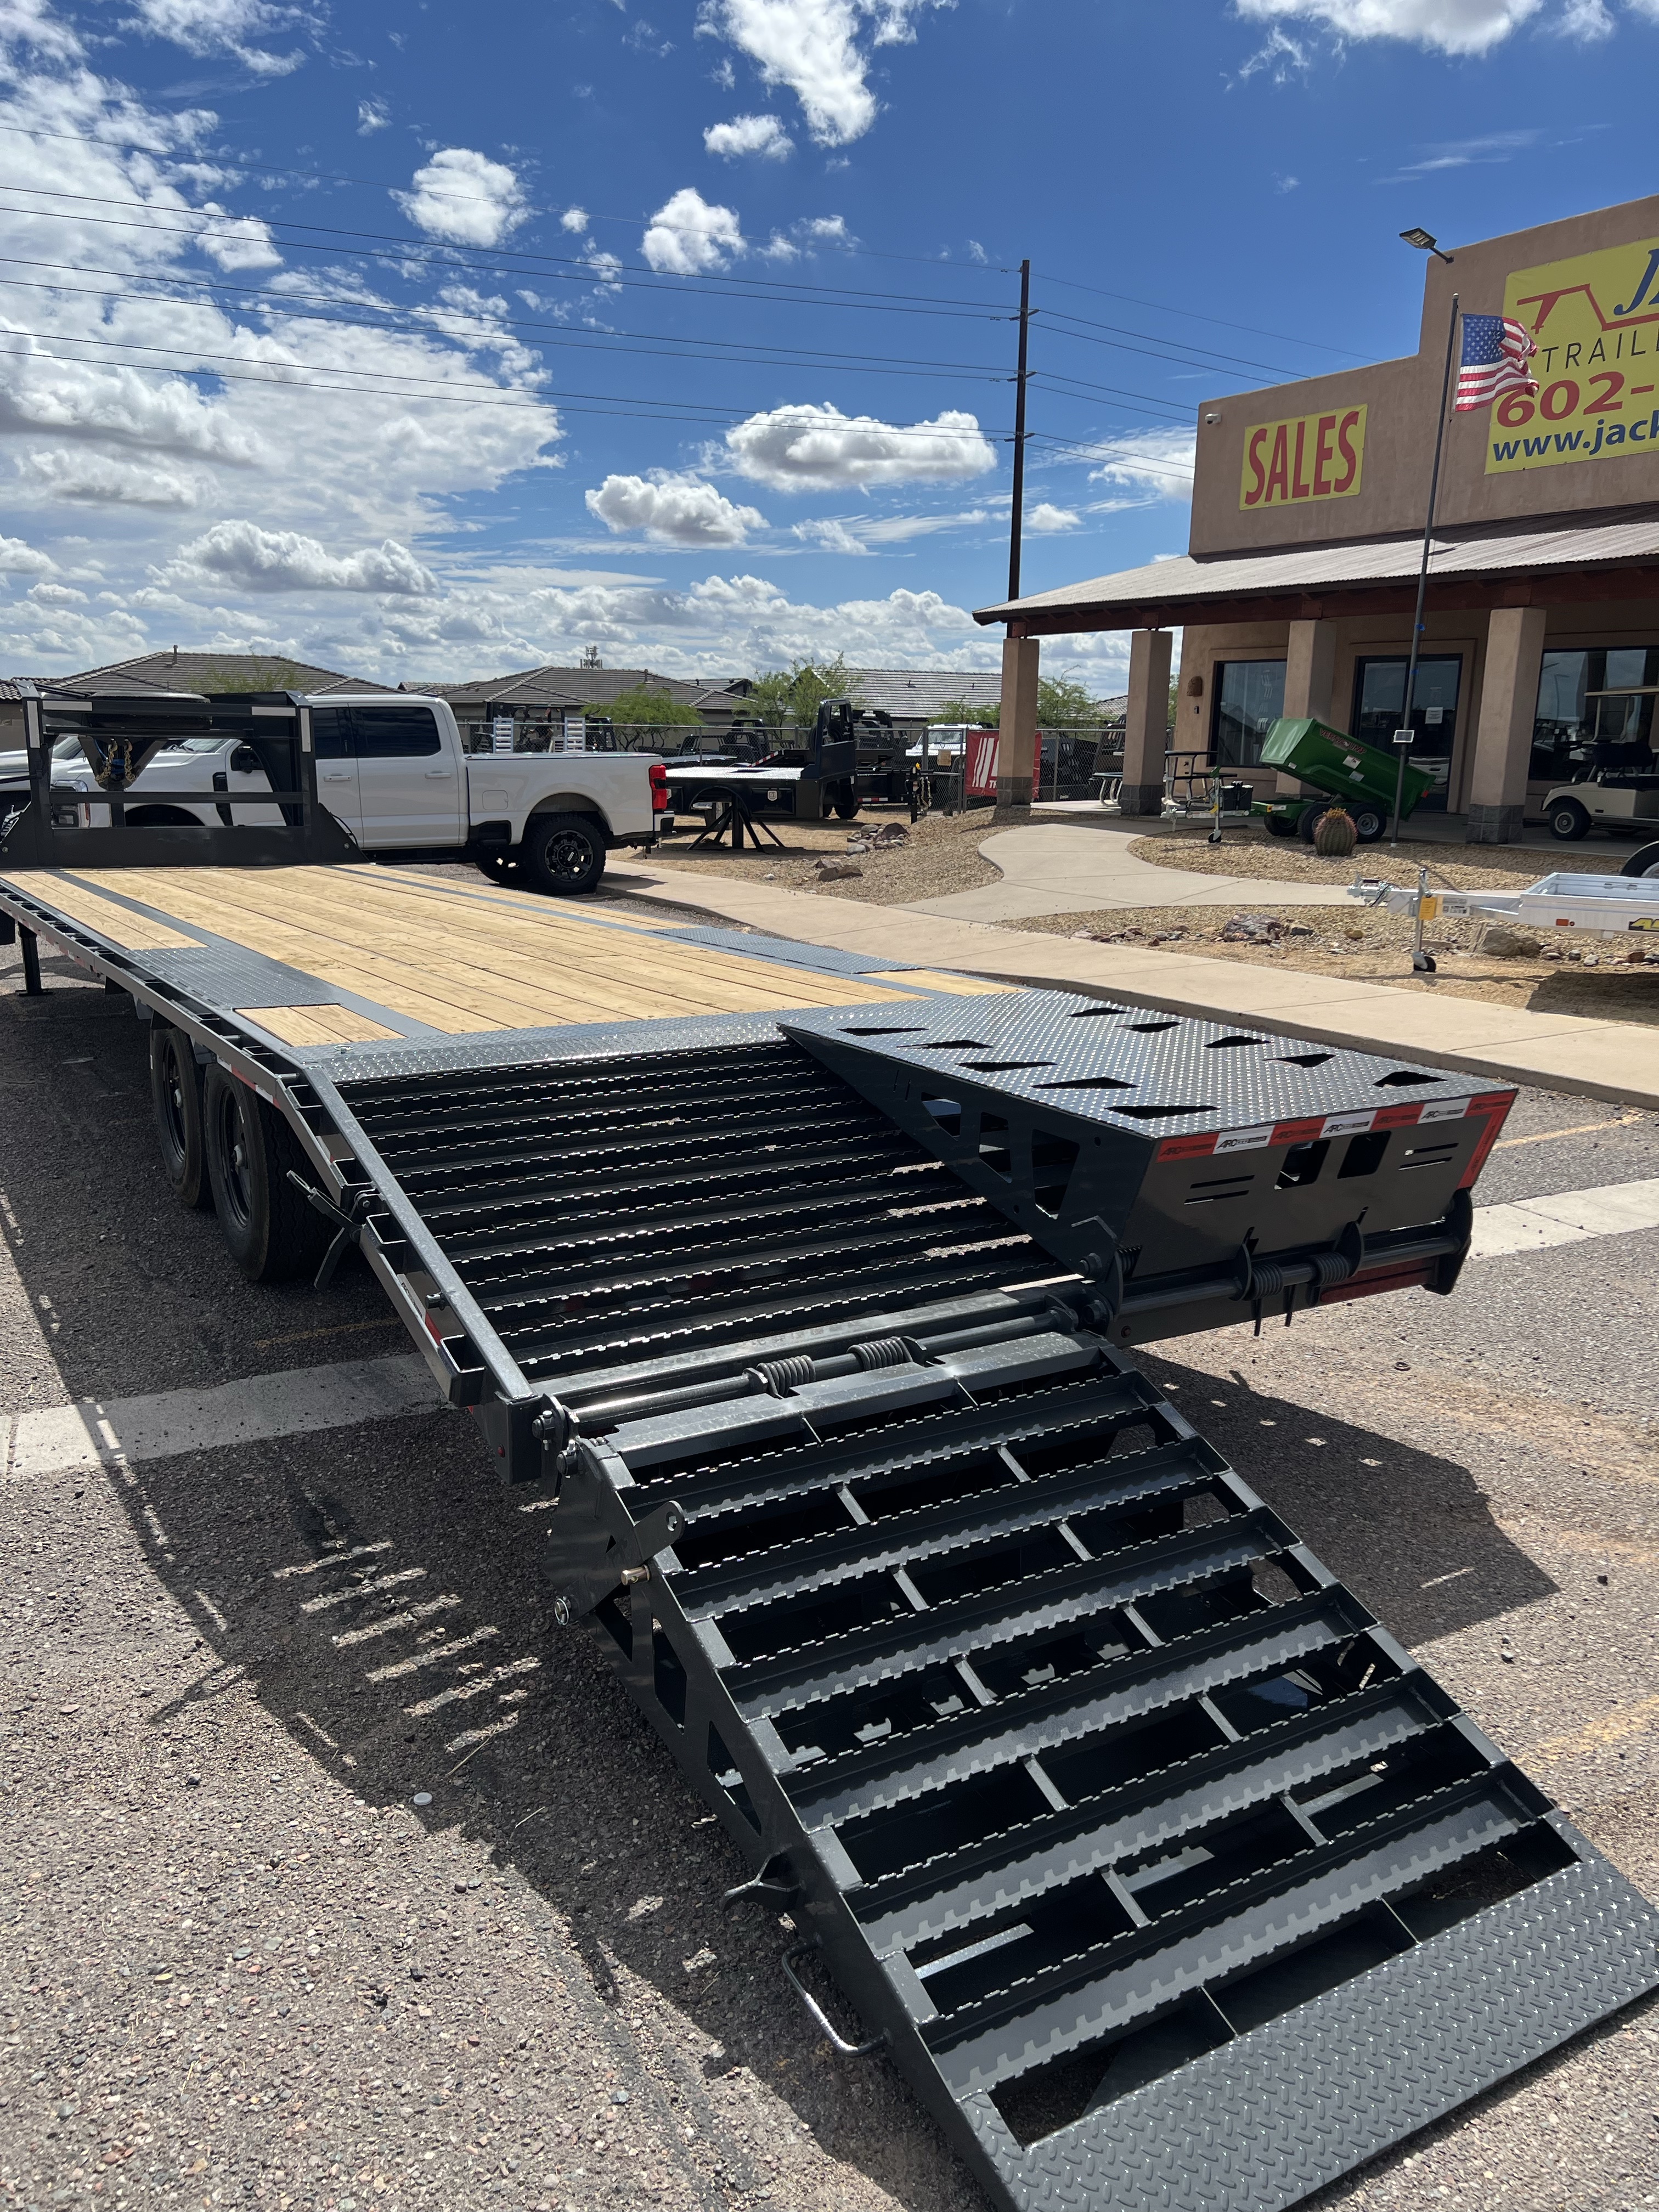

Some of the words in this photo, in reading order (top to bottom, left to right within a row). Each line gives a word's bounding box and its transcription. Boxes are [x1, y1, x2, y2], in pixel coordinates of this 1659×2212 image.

[1613, 249, 1659, 316] J
[1542, 328, 1659, 373] TRAIL
[1497, 371, 1655, 428] 602-
[1245, 410, 1359, 505] SALES
[1216, 1138, 1237, 1149] ARC
[1323, 1124, 1343, 1133] ARC
